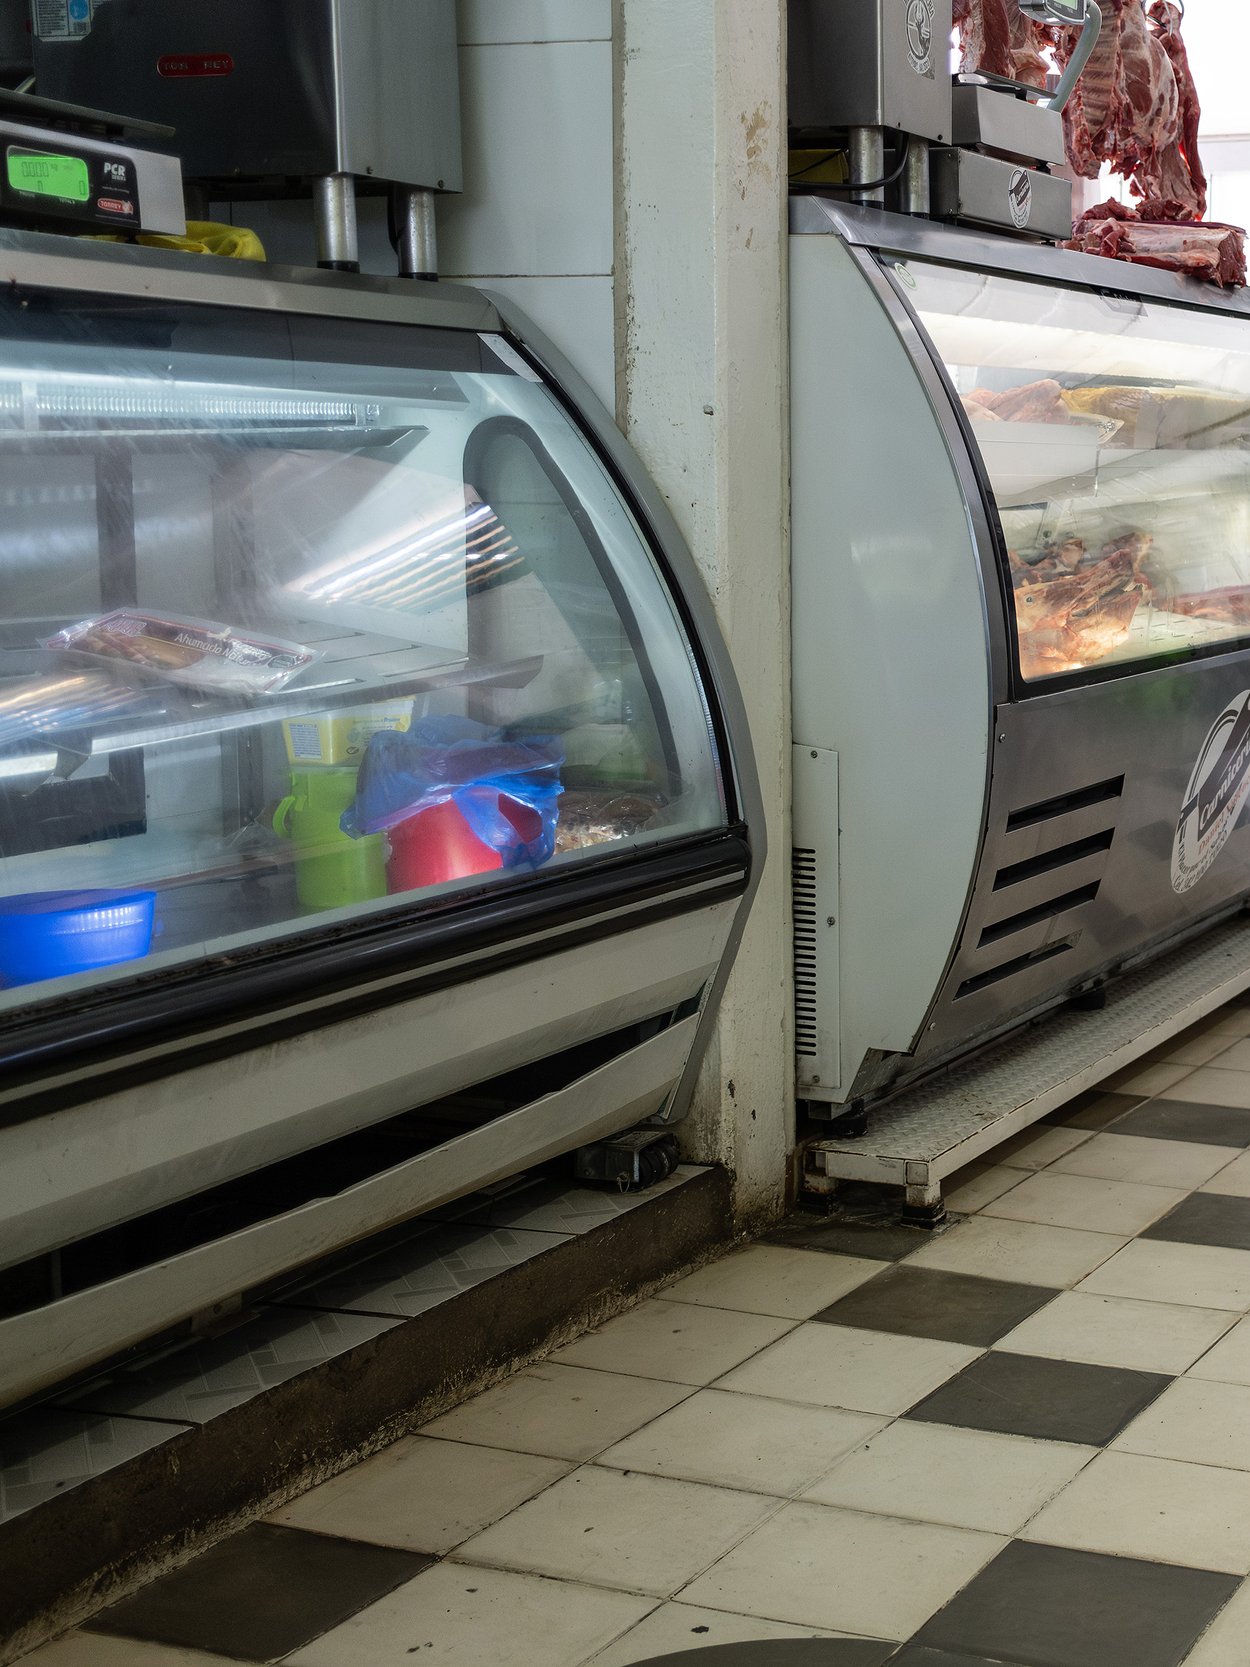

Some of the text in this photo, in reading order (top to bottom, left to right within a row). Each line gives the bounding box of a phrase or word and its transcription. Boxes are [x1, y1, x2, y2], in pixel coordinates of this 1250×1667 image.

[103, 162, 126, 177] PCR
[175, 632, 222, 656] Ahumado
[222, 647, 258, 667] Natur
